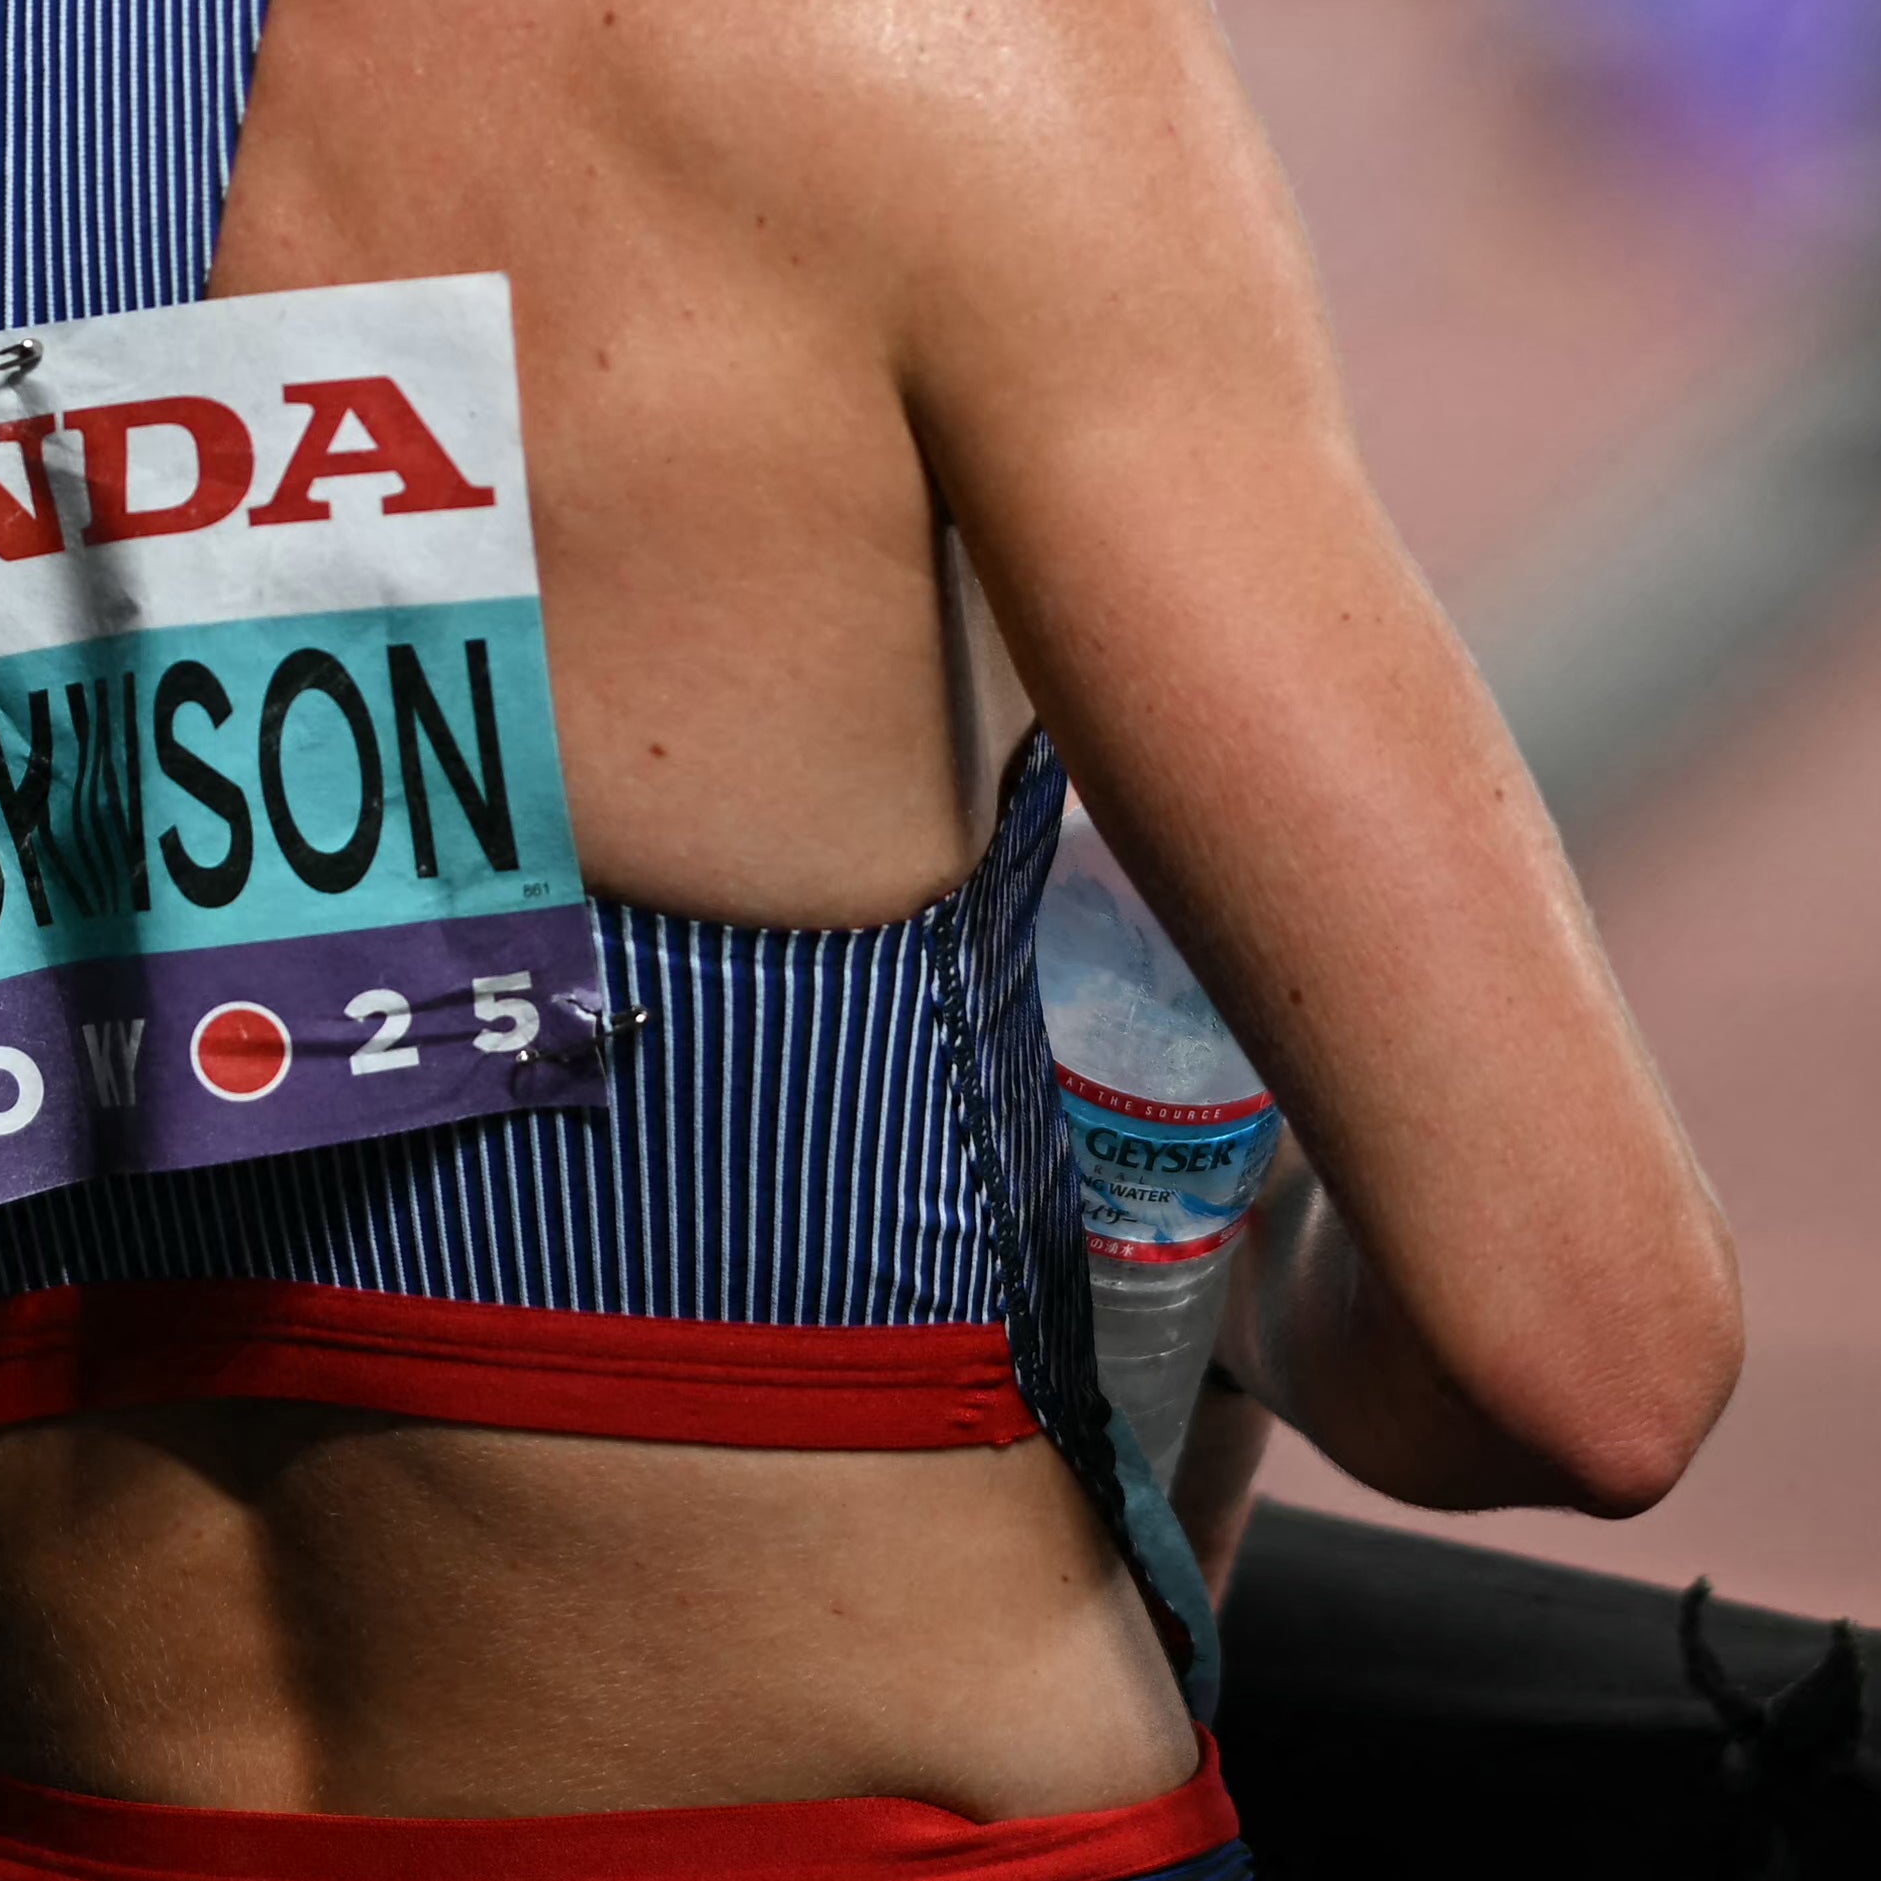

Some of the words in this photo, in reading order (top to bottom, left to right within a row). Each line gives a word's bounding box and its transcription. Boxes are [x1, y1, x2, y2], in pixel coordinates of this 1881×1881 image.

[1065, 1076, 1087, 1093] AT
[1098, 1090, 1133, 1112] THE
[1145, 1105, 1222, 1121] SOURCE
[1085, 1126, 1237, 1174] GEYSER
[1109, 1182, 1171, 1203] WATER
